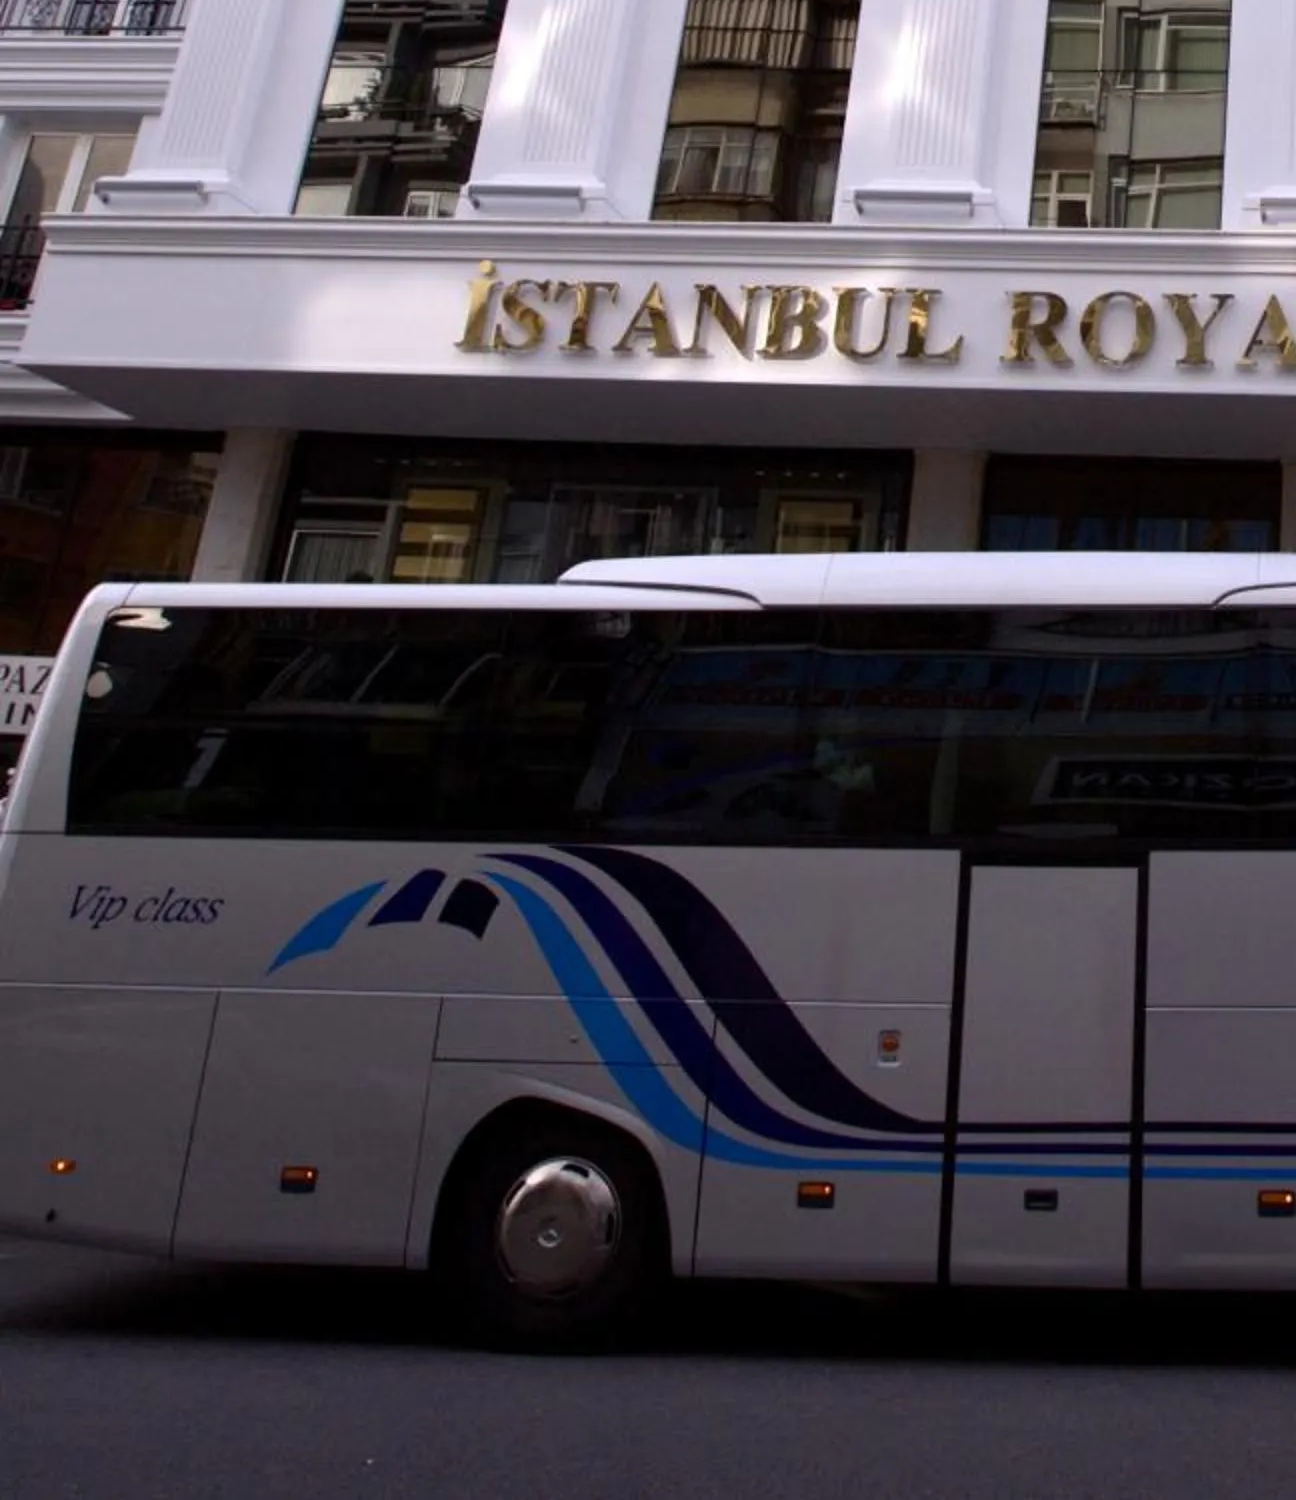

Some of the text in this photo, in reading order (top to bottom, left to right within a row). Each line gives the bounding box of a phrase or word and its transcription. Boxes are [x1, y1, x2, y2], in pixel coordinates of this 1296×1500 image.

[453, 259, 966, 364] İSTANBUL
[69, 884, 225, 930] Vip class
